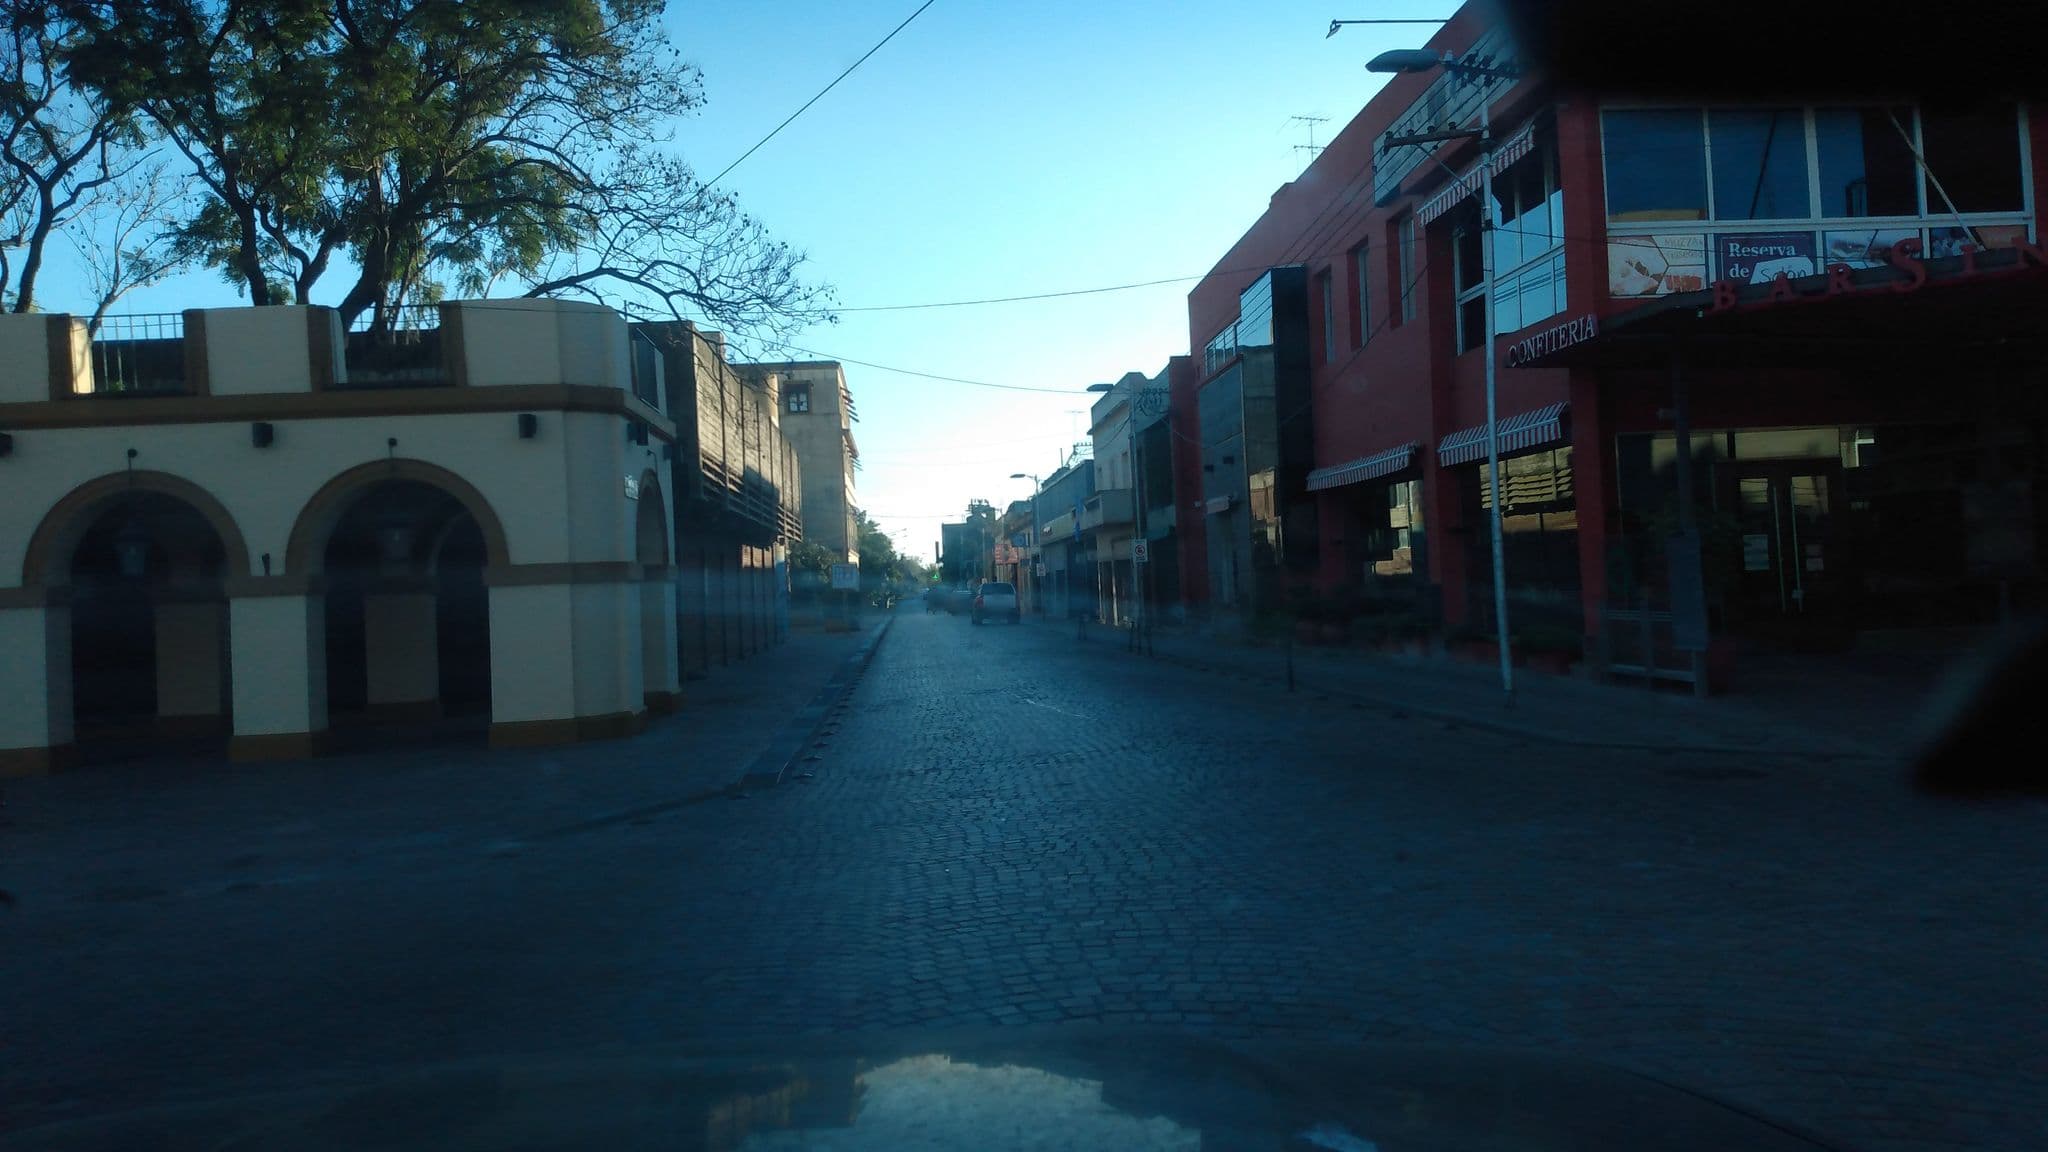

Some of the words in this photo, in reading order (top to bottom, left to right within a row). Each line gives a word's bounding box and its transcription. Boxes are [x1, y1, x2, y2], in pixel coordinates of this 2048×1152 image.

[1728, 242, 1797, 257] Reserva
[1728, 263, 1750, 278] de
[1713, 263, 1857, 311] BAR
[1507, 312, 1596, 368] CONFITERIA
